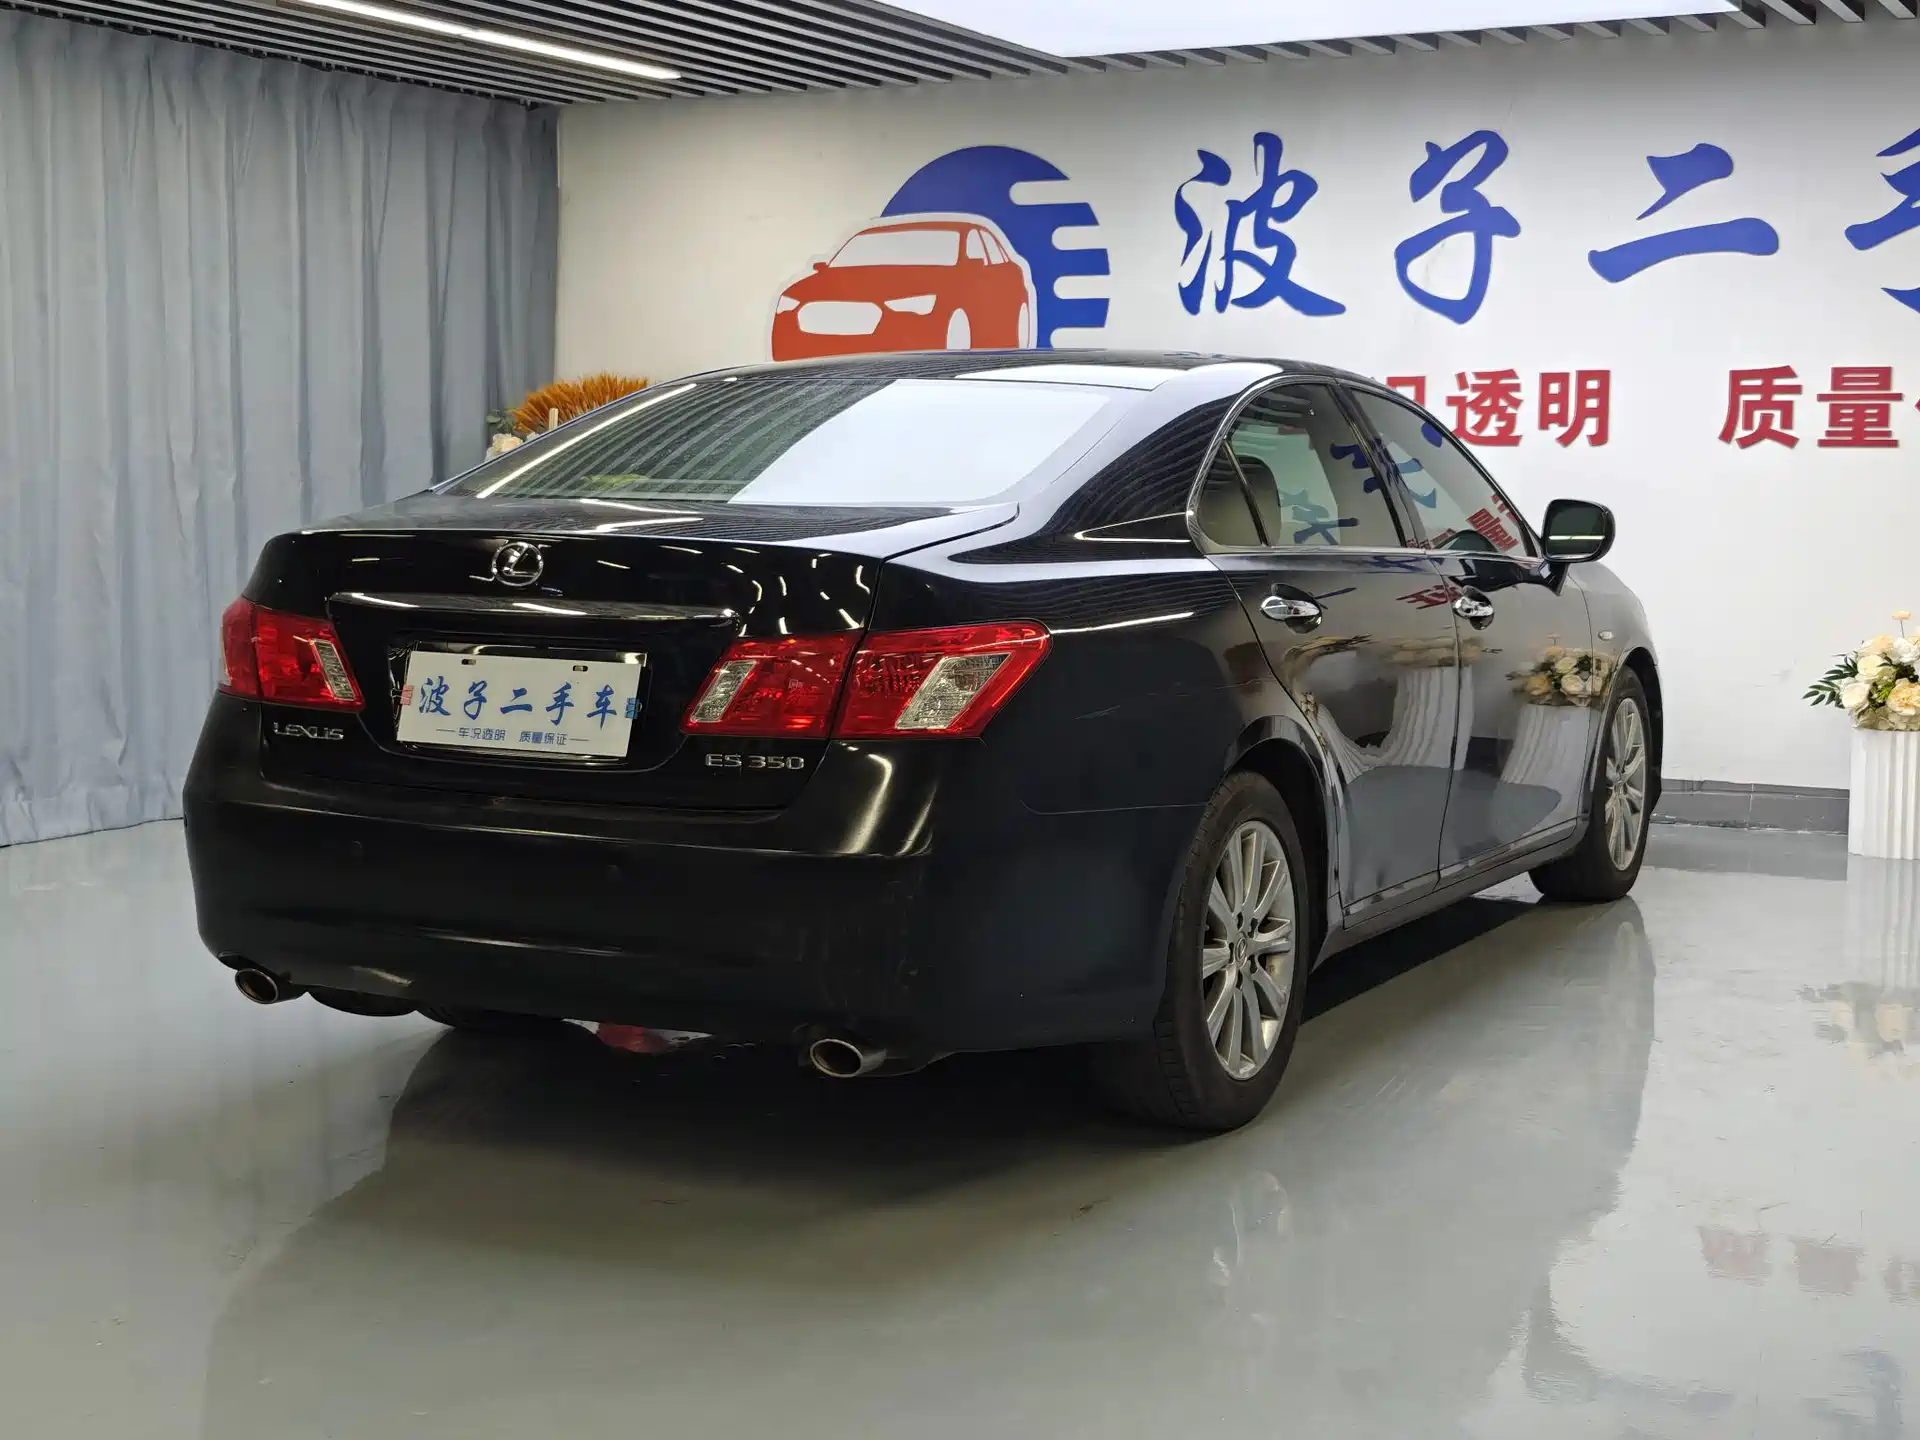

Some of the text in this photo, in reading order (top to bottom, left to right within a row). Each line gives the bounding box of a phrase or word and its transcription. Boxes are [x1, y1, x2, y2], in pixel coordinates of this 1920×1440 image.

[1718, 365, 1920, 450] 质量
[418, 675, 618, 730] 波子二手车
[272, 721, 345, 741] LEXUS
[457, 727, 569, 746] 车况透明 质量保证
[705, 753, 805, 770] ES 350
